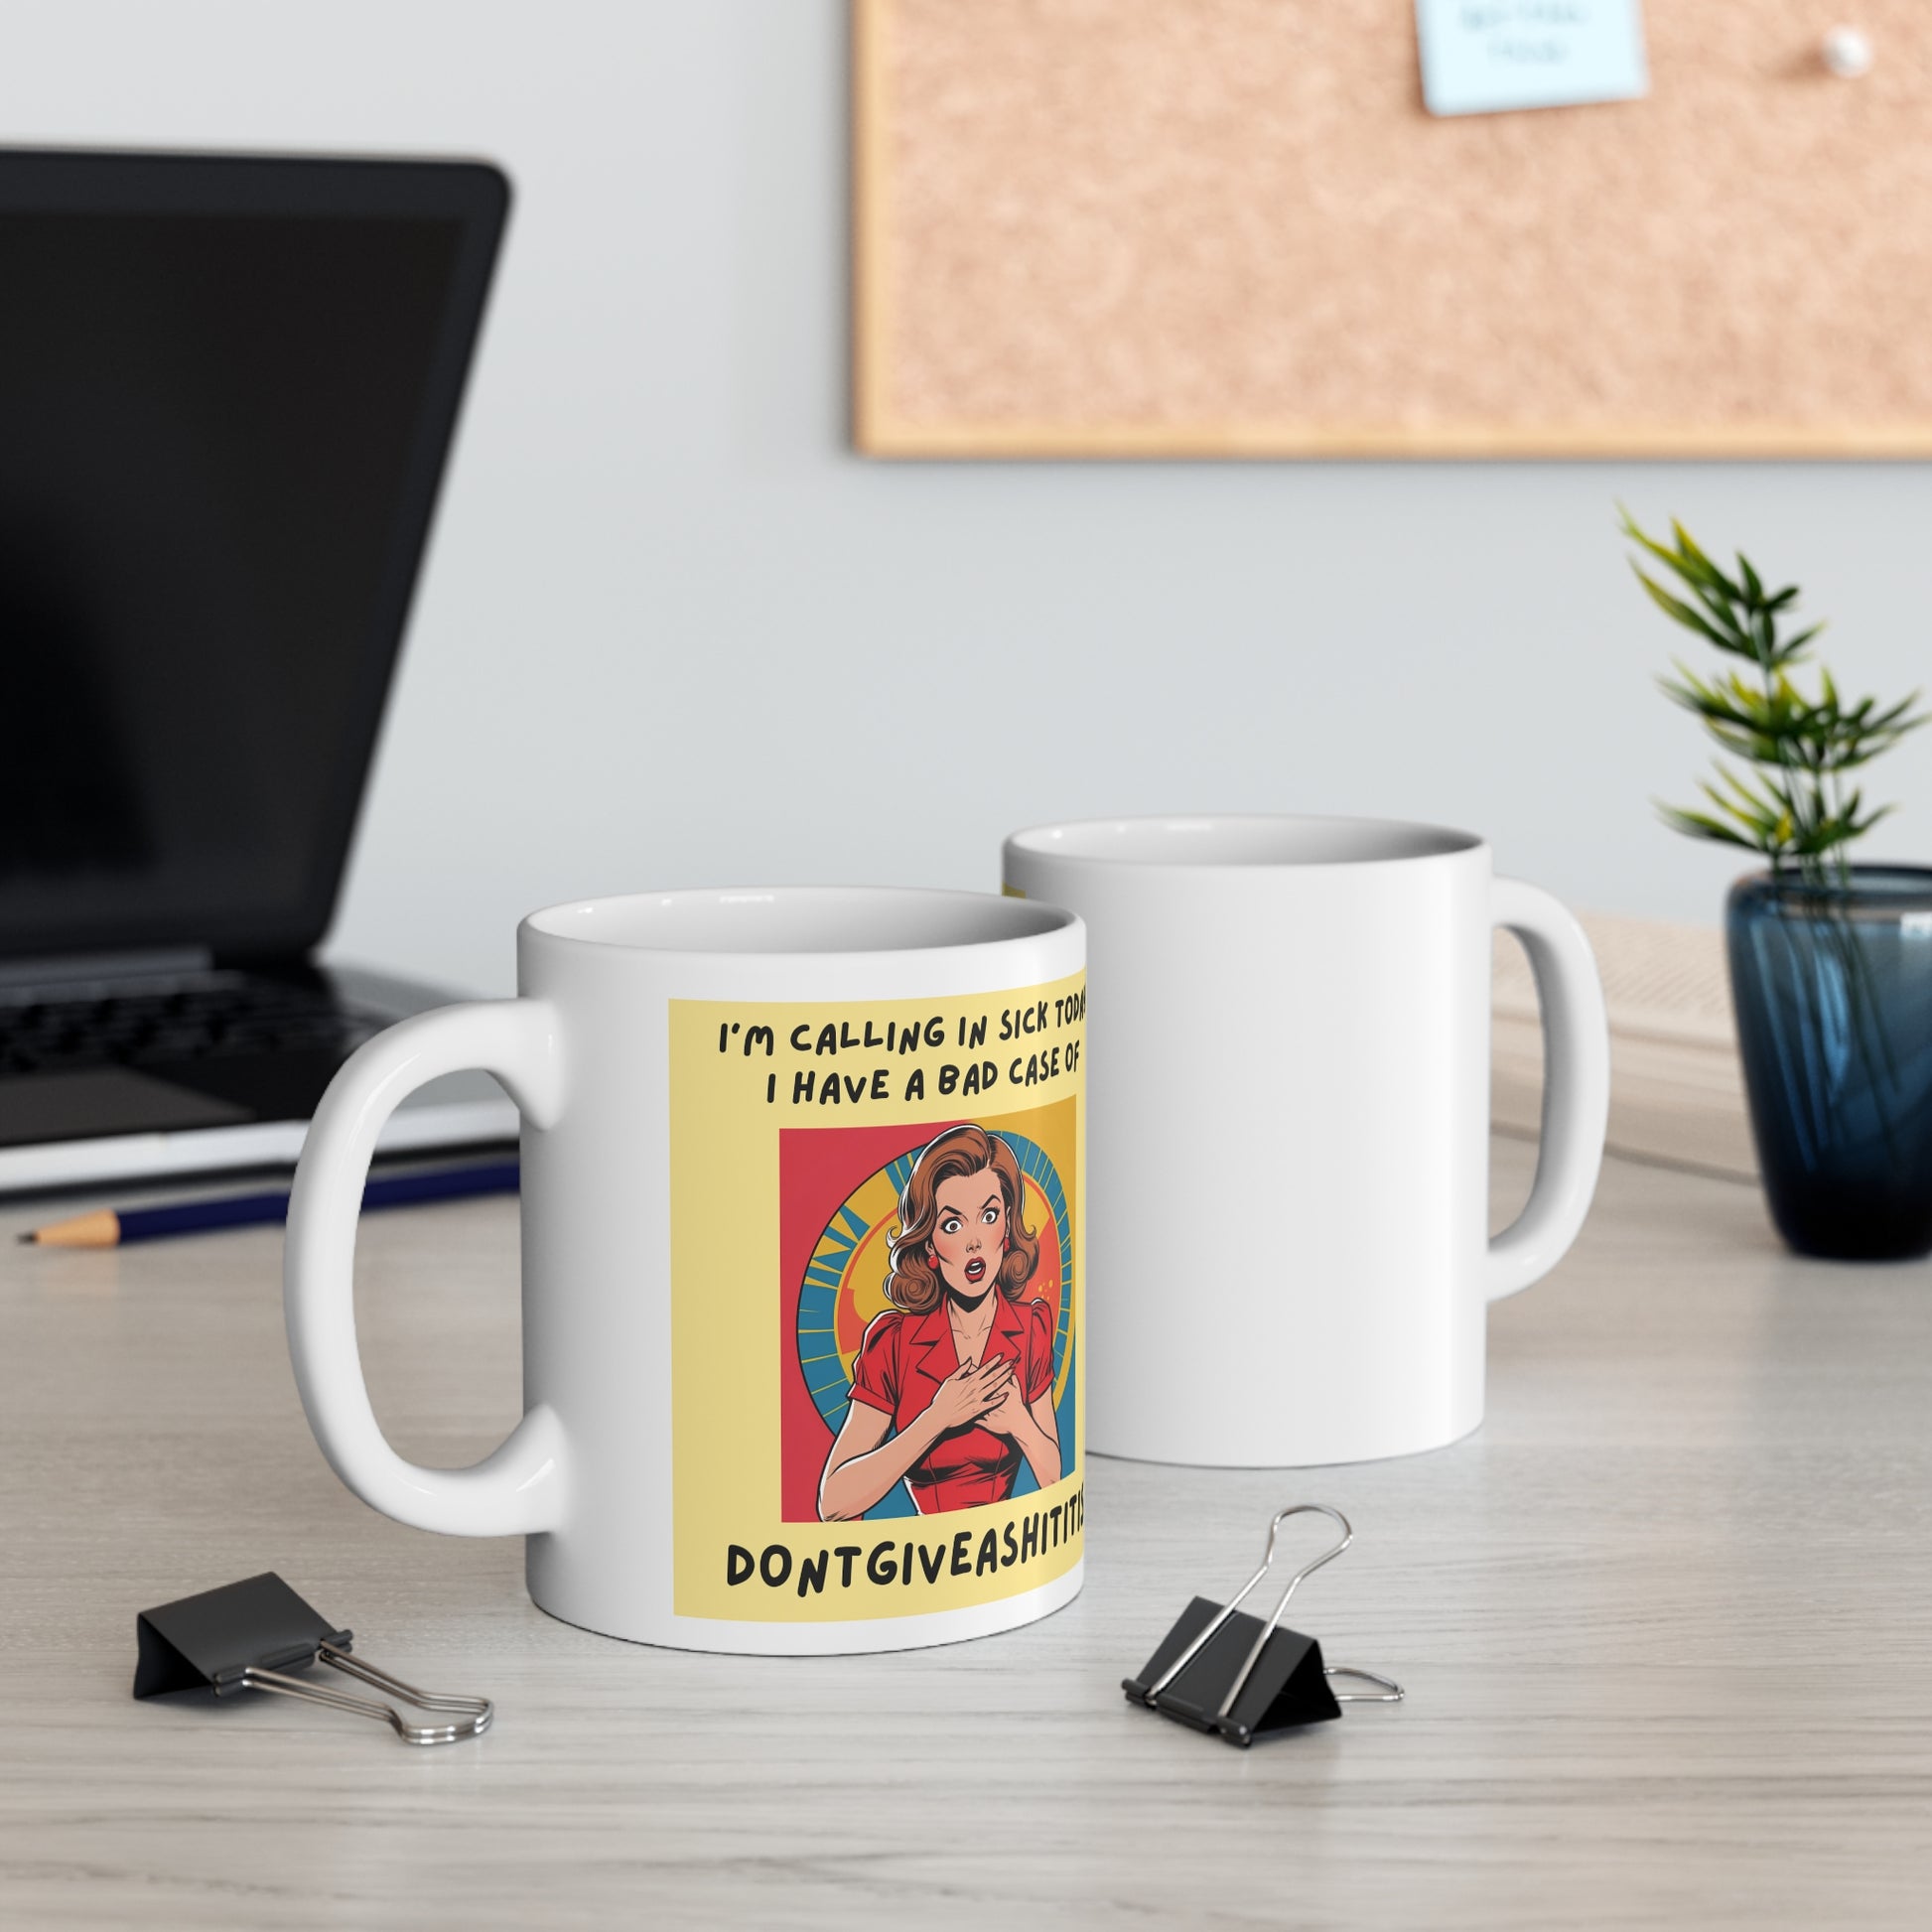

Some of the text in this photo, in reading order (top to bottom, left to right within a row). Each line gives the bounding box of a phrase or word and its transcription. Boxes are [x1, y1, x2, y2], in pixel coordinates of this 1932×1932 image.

[719, 1023, 774, 1056] I'M
[789, 1016, 945, 1056] CALLING
[958, 1015, 988, 1049] IN
[999, 1001, 1048, 1041] SICK
[766, 1039, 1080, 1105] I HAVE A BAD CASE OF
